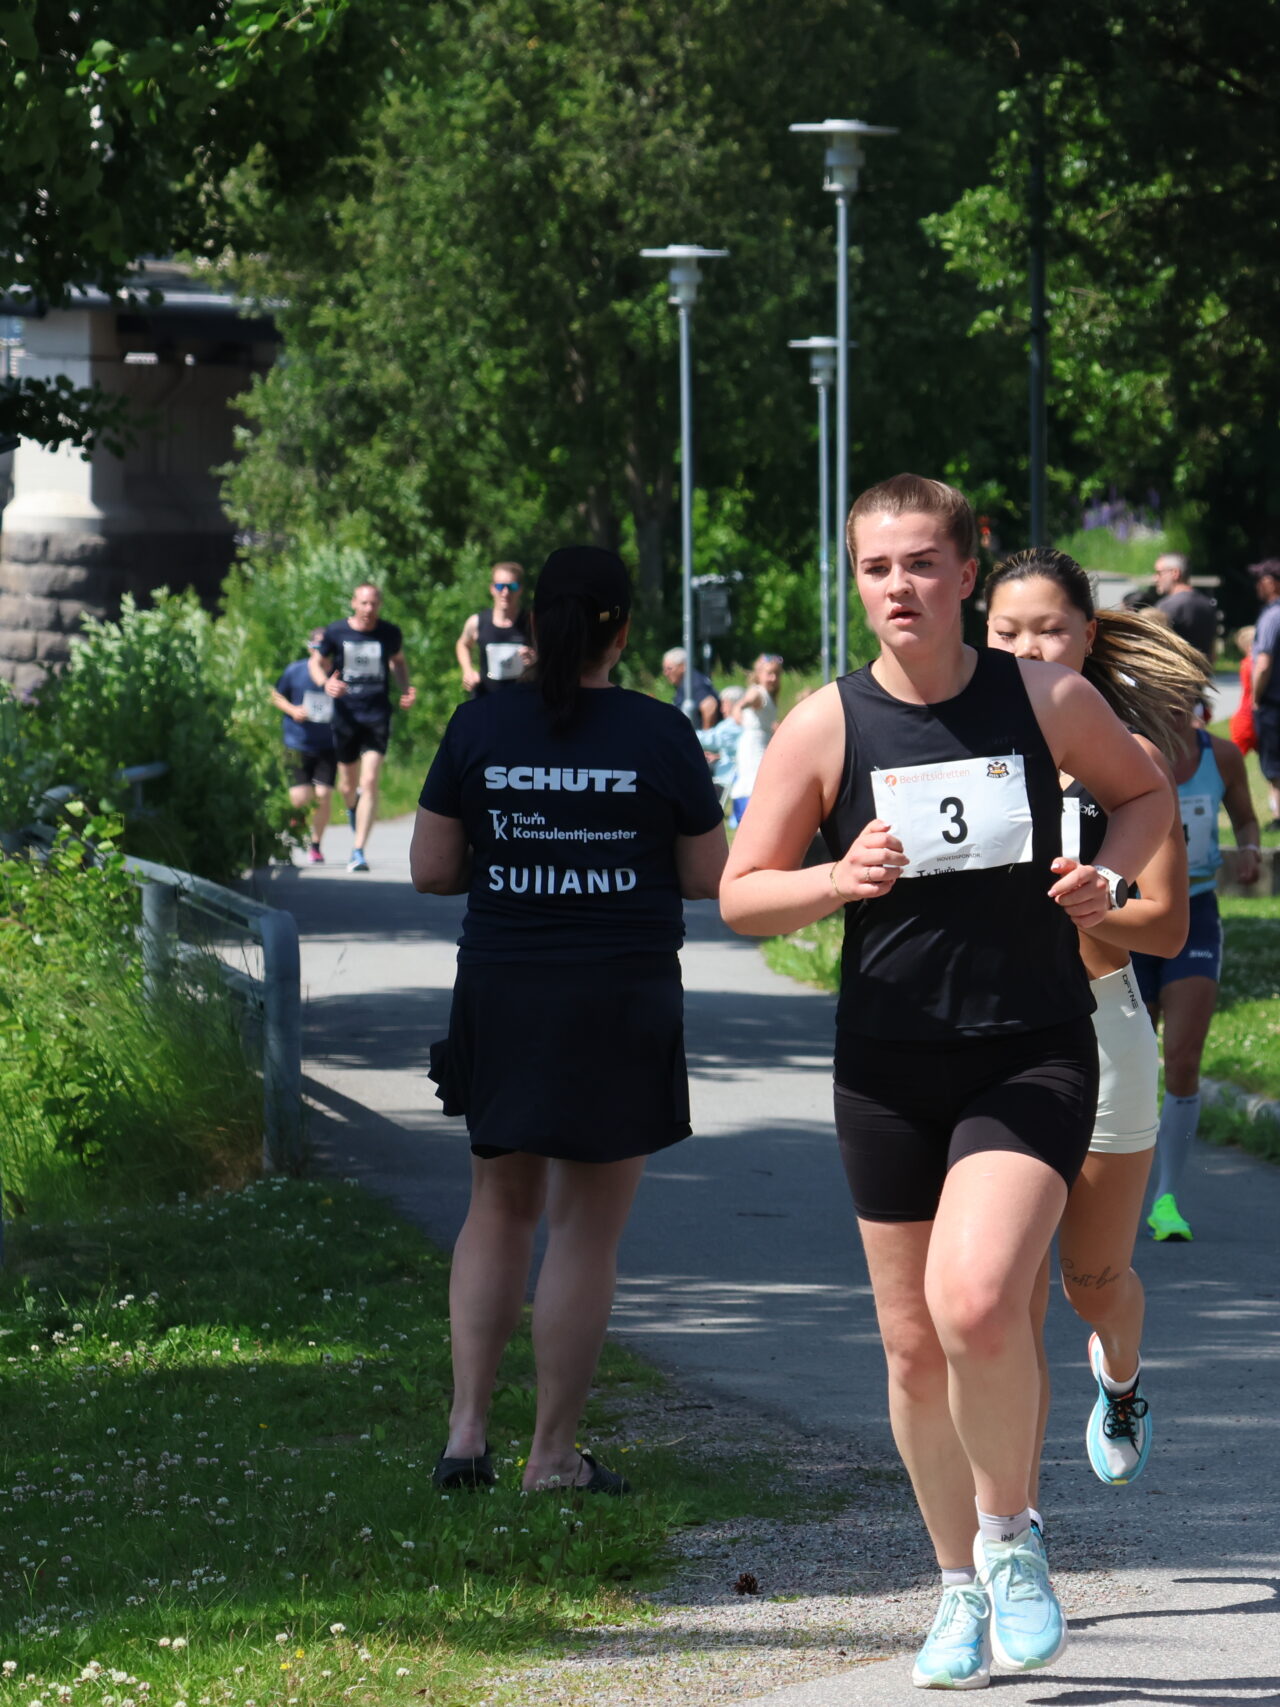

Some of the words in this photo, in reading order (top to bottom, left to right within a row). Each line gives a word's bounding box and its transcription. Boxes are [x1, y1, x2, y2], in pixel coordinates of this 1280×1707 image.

[484, 766, 637, 792] SCHÜTZ
[899, 768, 970, 785] Bedriftsidretten
[939, 796, 968, 845] 3
[512, 827, 637, 844] Konsulenttjenester
